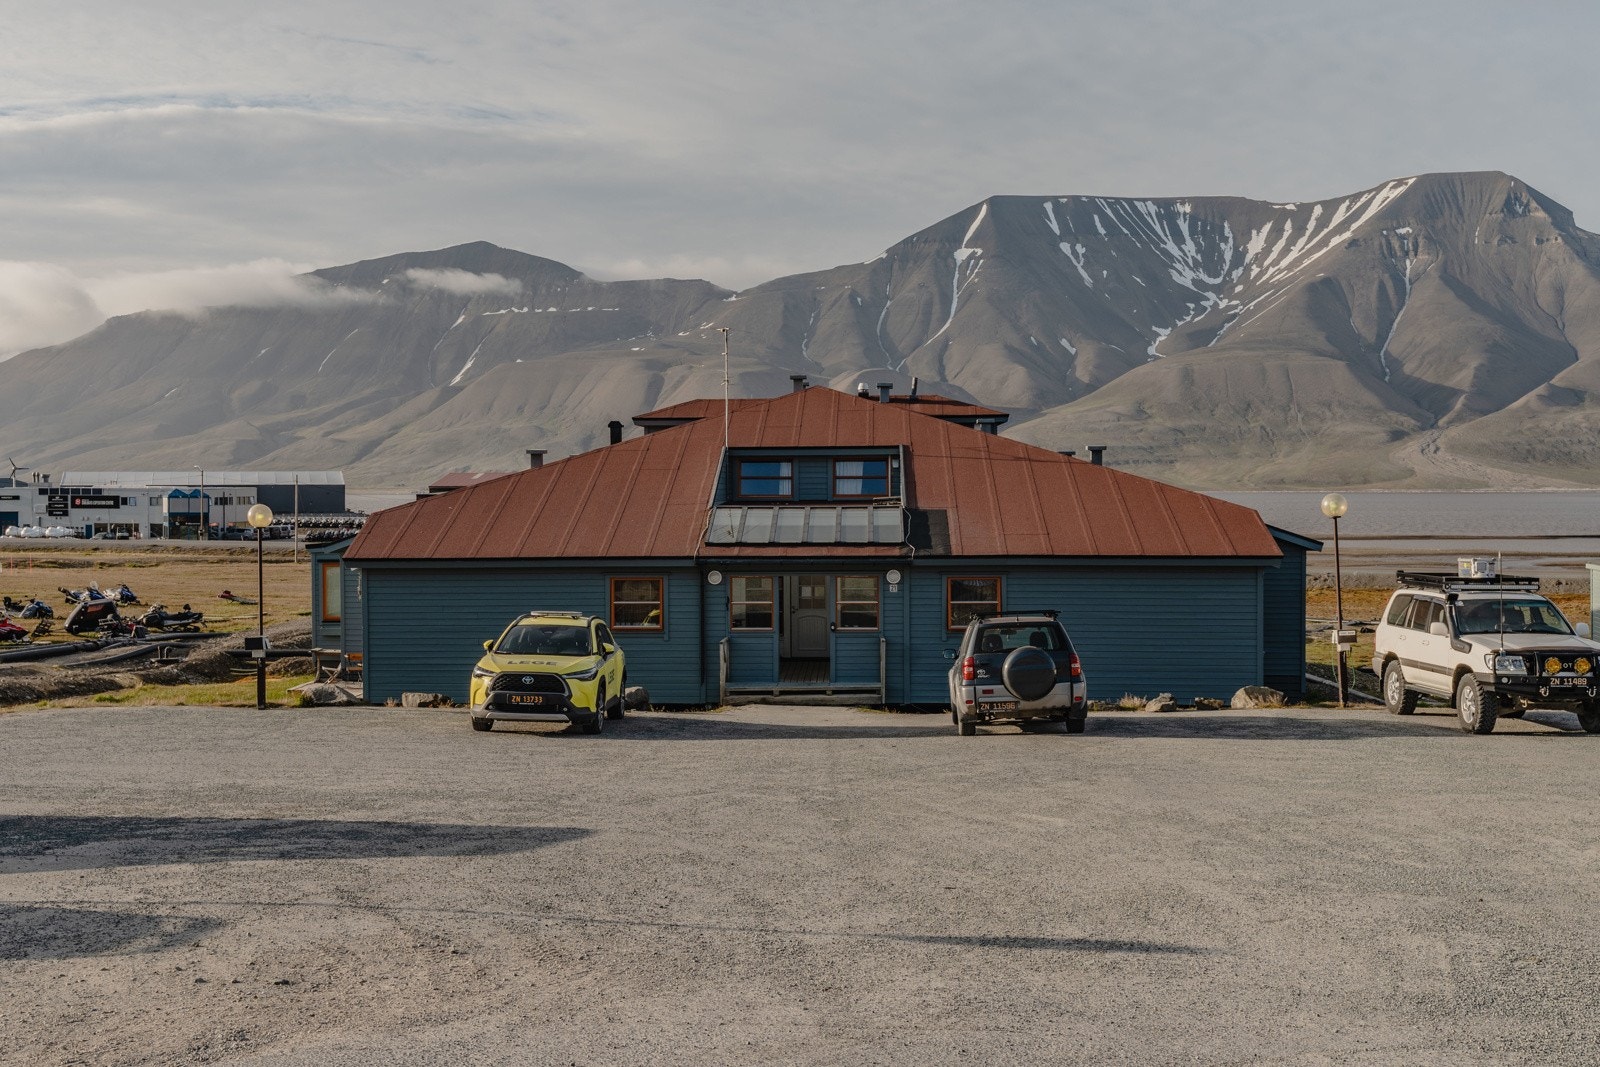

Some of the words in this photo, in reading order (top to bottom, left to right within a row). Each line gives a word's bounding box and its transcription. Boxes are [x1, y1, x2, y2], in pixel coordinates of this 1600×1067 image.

[1550, 677, 1560, 685] ZN
[511, 695, 521, 703] ZN
[523, 695, 543, 703] 13733
[980, 702, 990, 710] ZN
